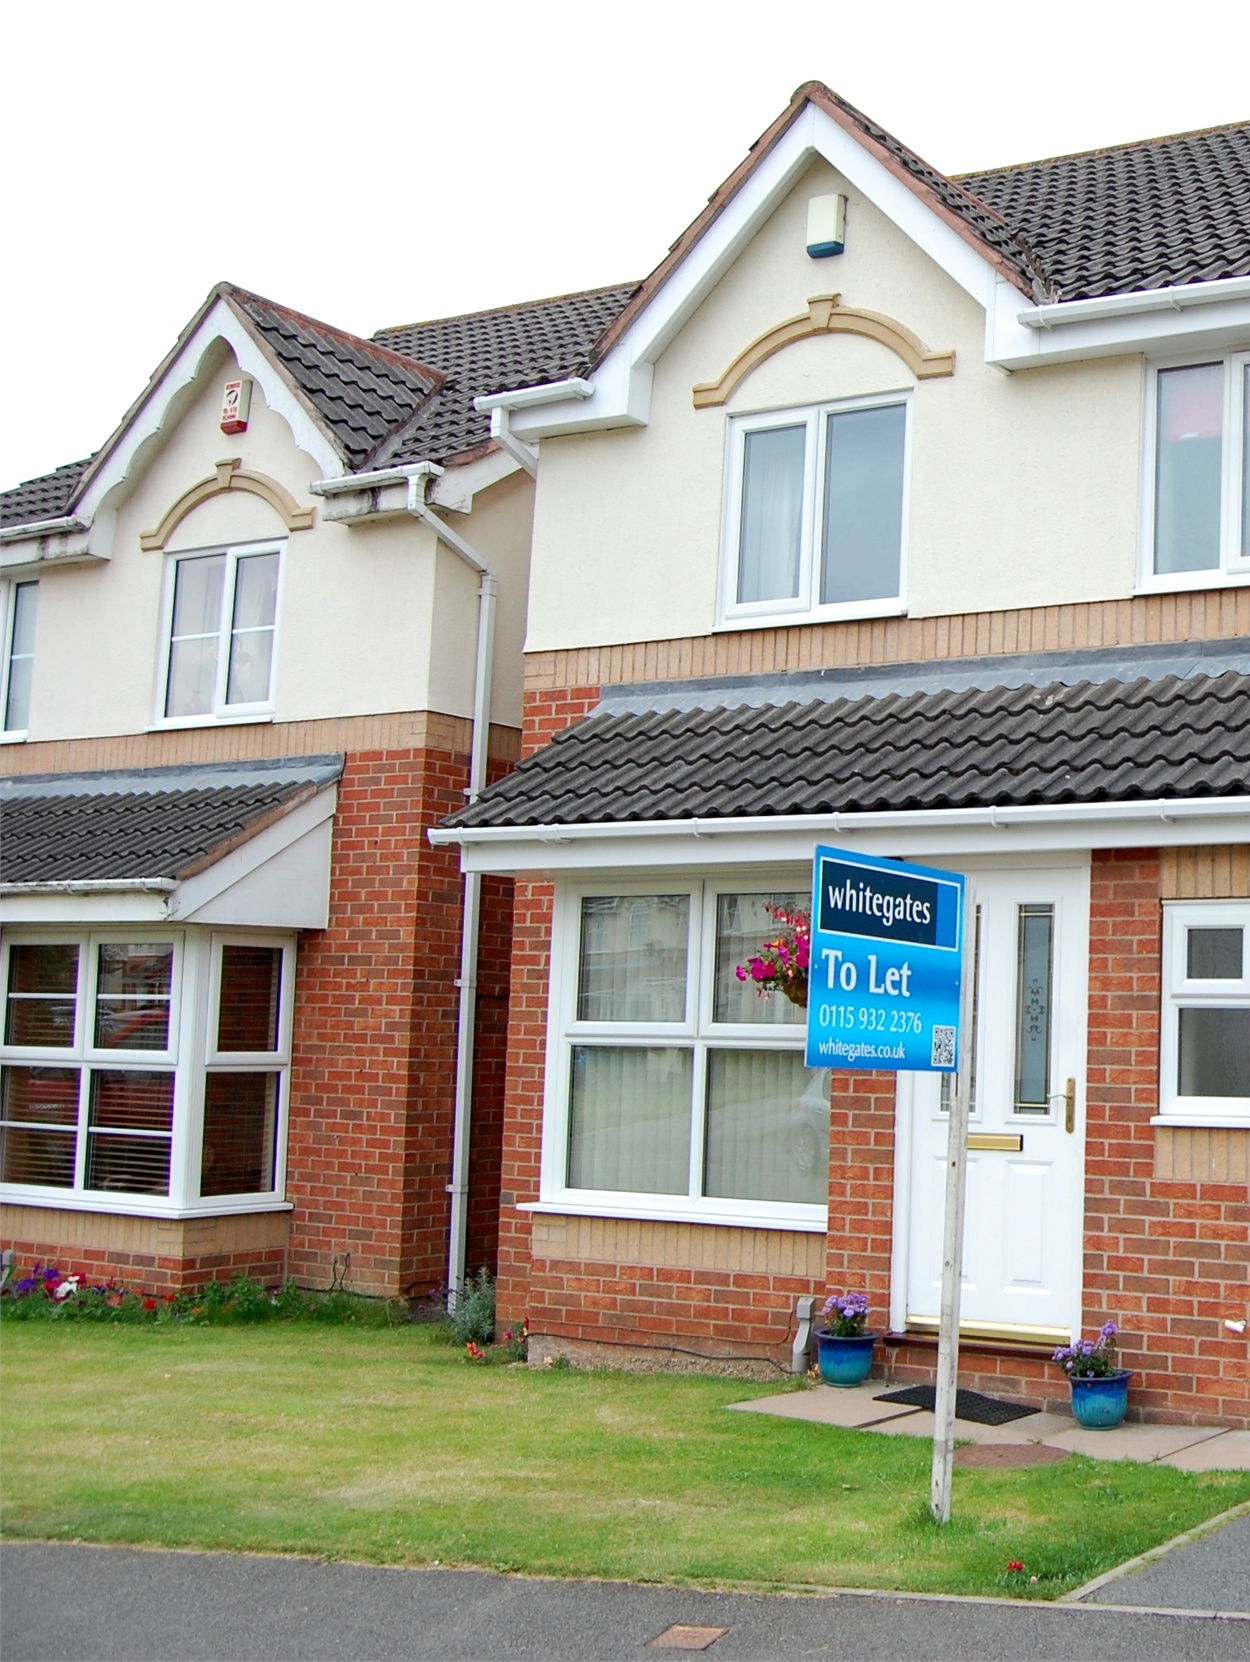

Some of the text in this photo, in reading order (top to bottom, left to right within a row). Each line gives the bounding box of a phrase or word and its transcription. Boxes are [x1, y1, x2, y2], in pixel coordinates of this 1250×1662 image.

[828, 879, 931, 927] whitegates
[822, 949, 912, 997] To Let
[819, 1004, 922, 1033] 0115 932 2376
[819, 1037, 905, 1062] whitegates.co.uk
